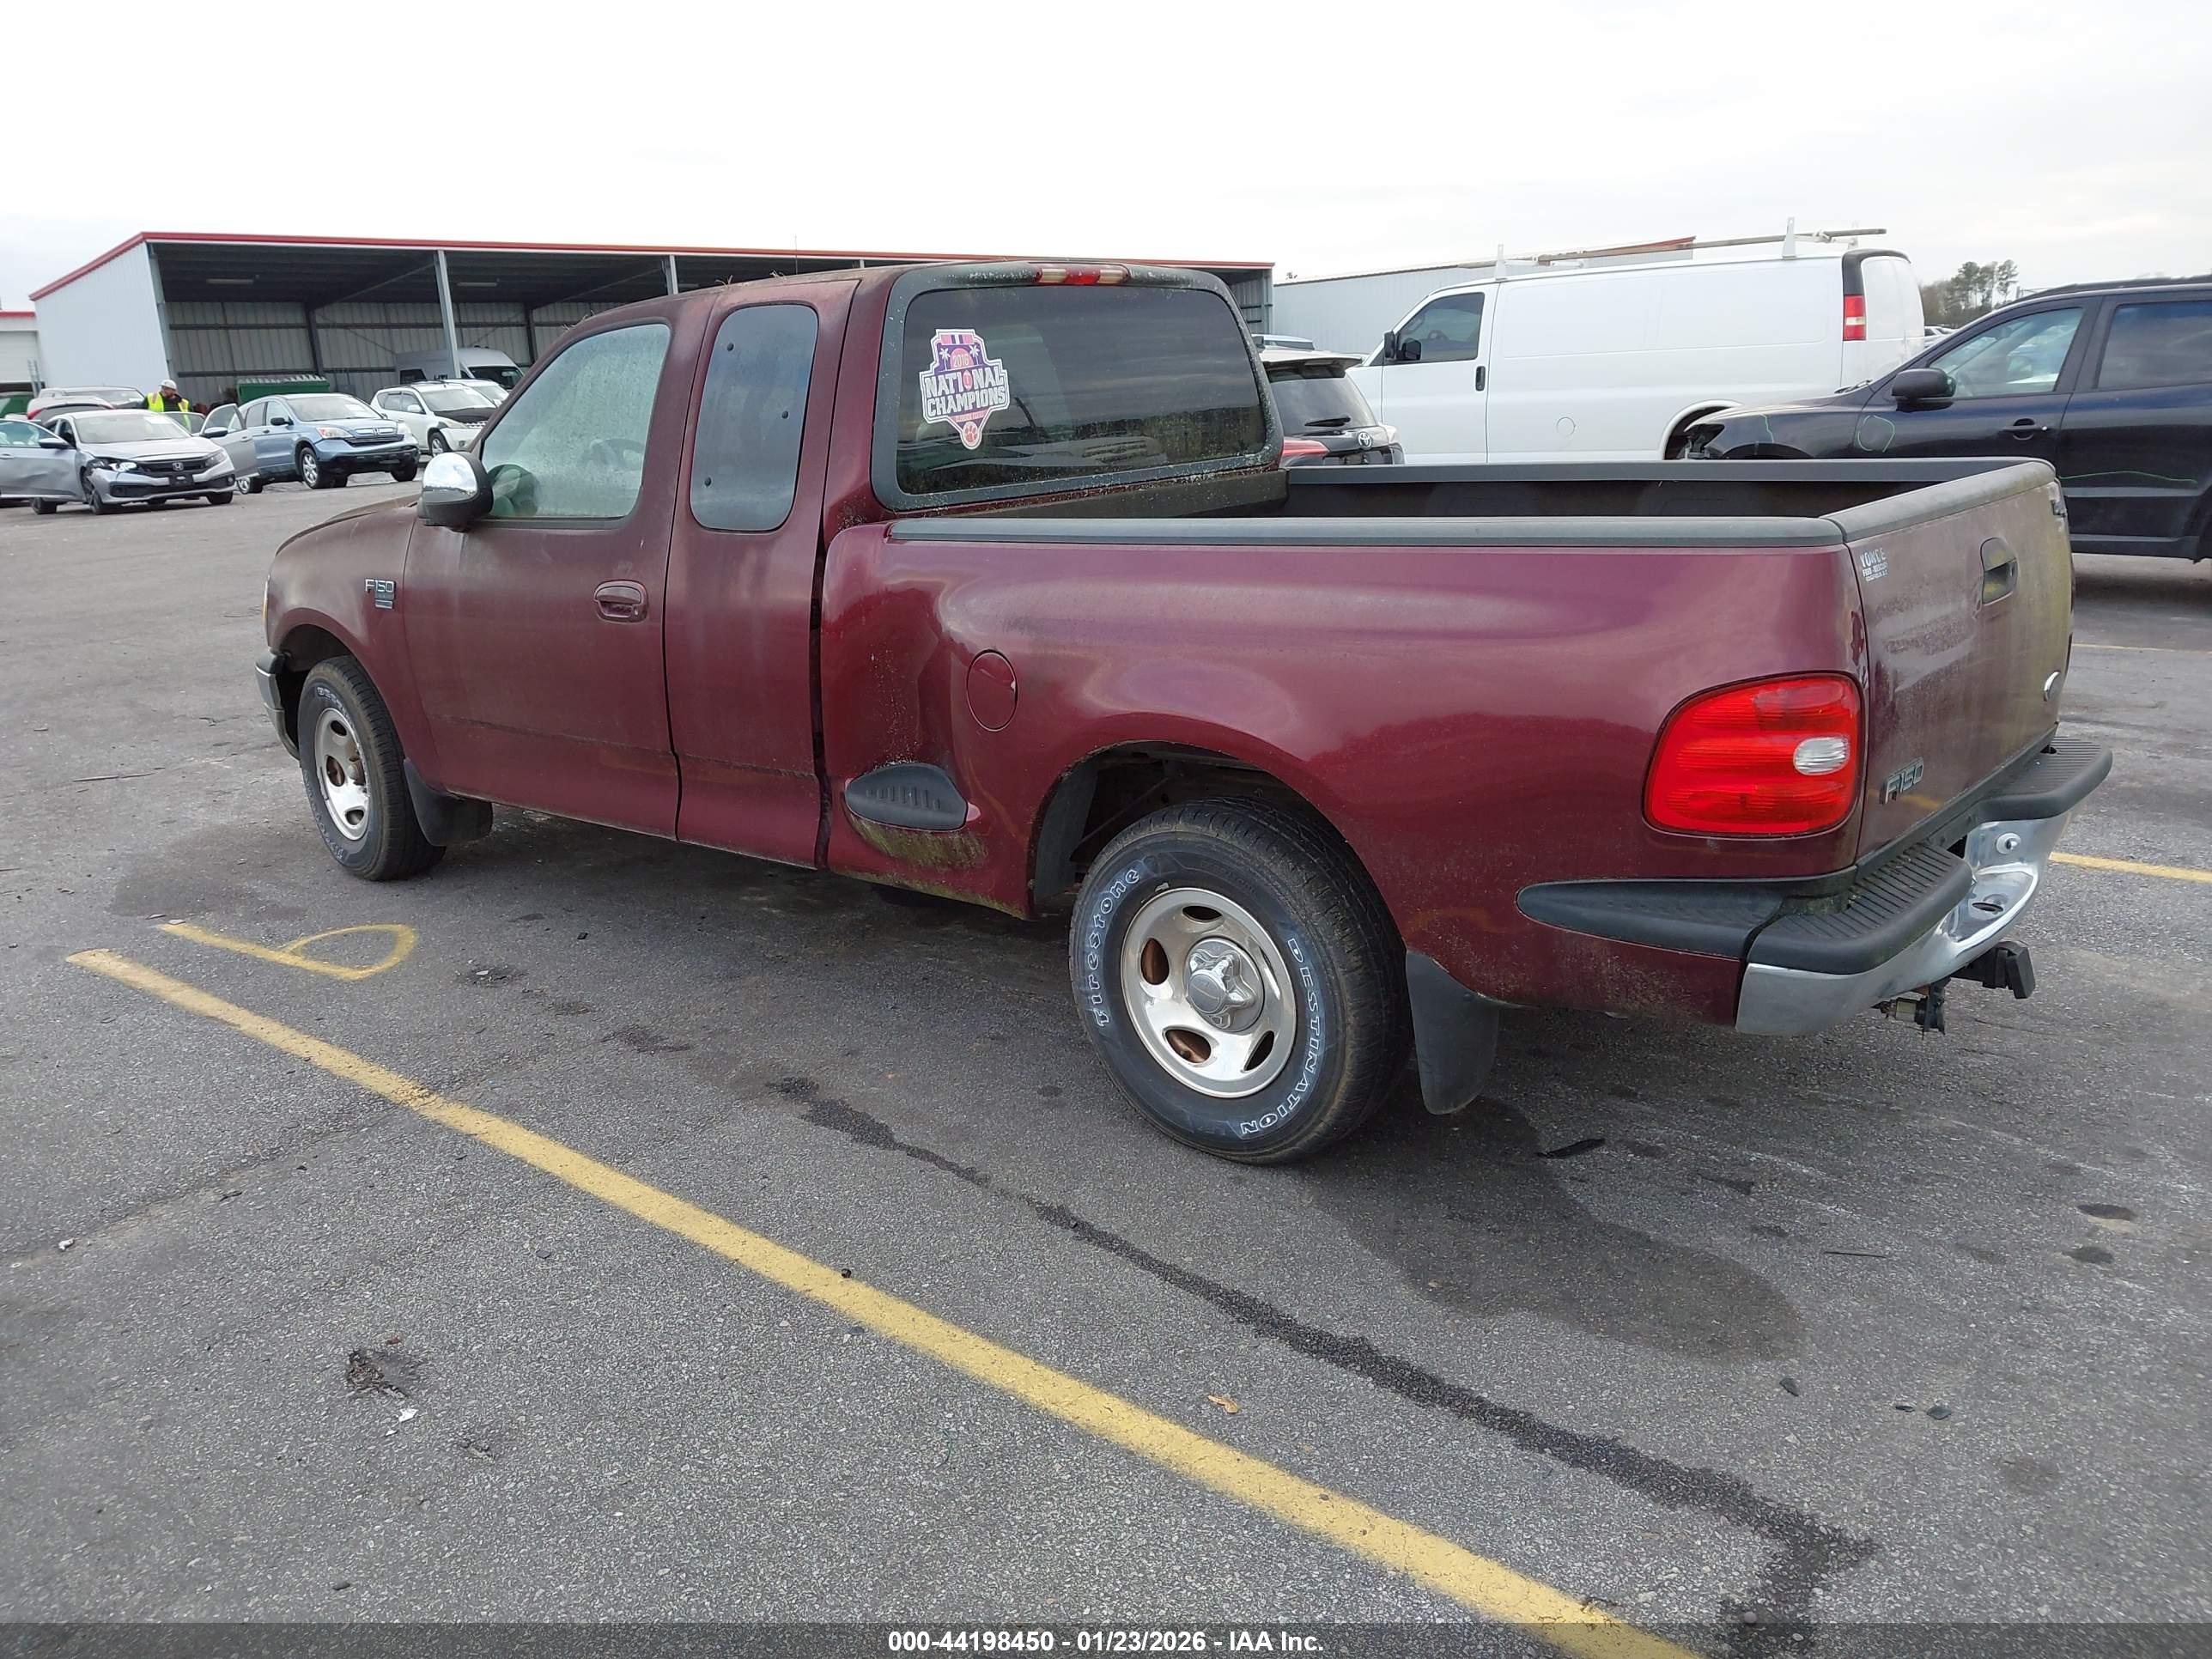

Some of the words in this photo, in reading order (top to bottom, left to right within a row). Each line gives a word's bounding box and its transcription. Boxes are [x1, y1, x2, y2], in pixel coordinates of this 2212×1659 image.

[953, 355, 969, 368] 2016
[927, 386, 1006, 416] CHAMPIONS
[366, 580, 394, 592] F150
[1884, 761, 1924, 805] F150
[1087, 869, 1139, 1027] Firestone
[1240, 938, 1321, 1135] DESTINATION
